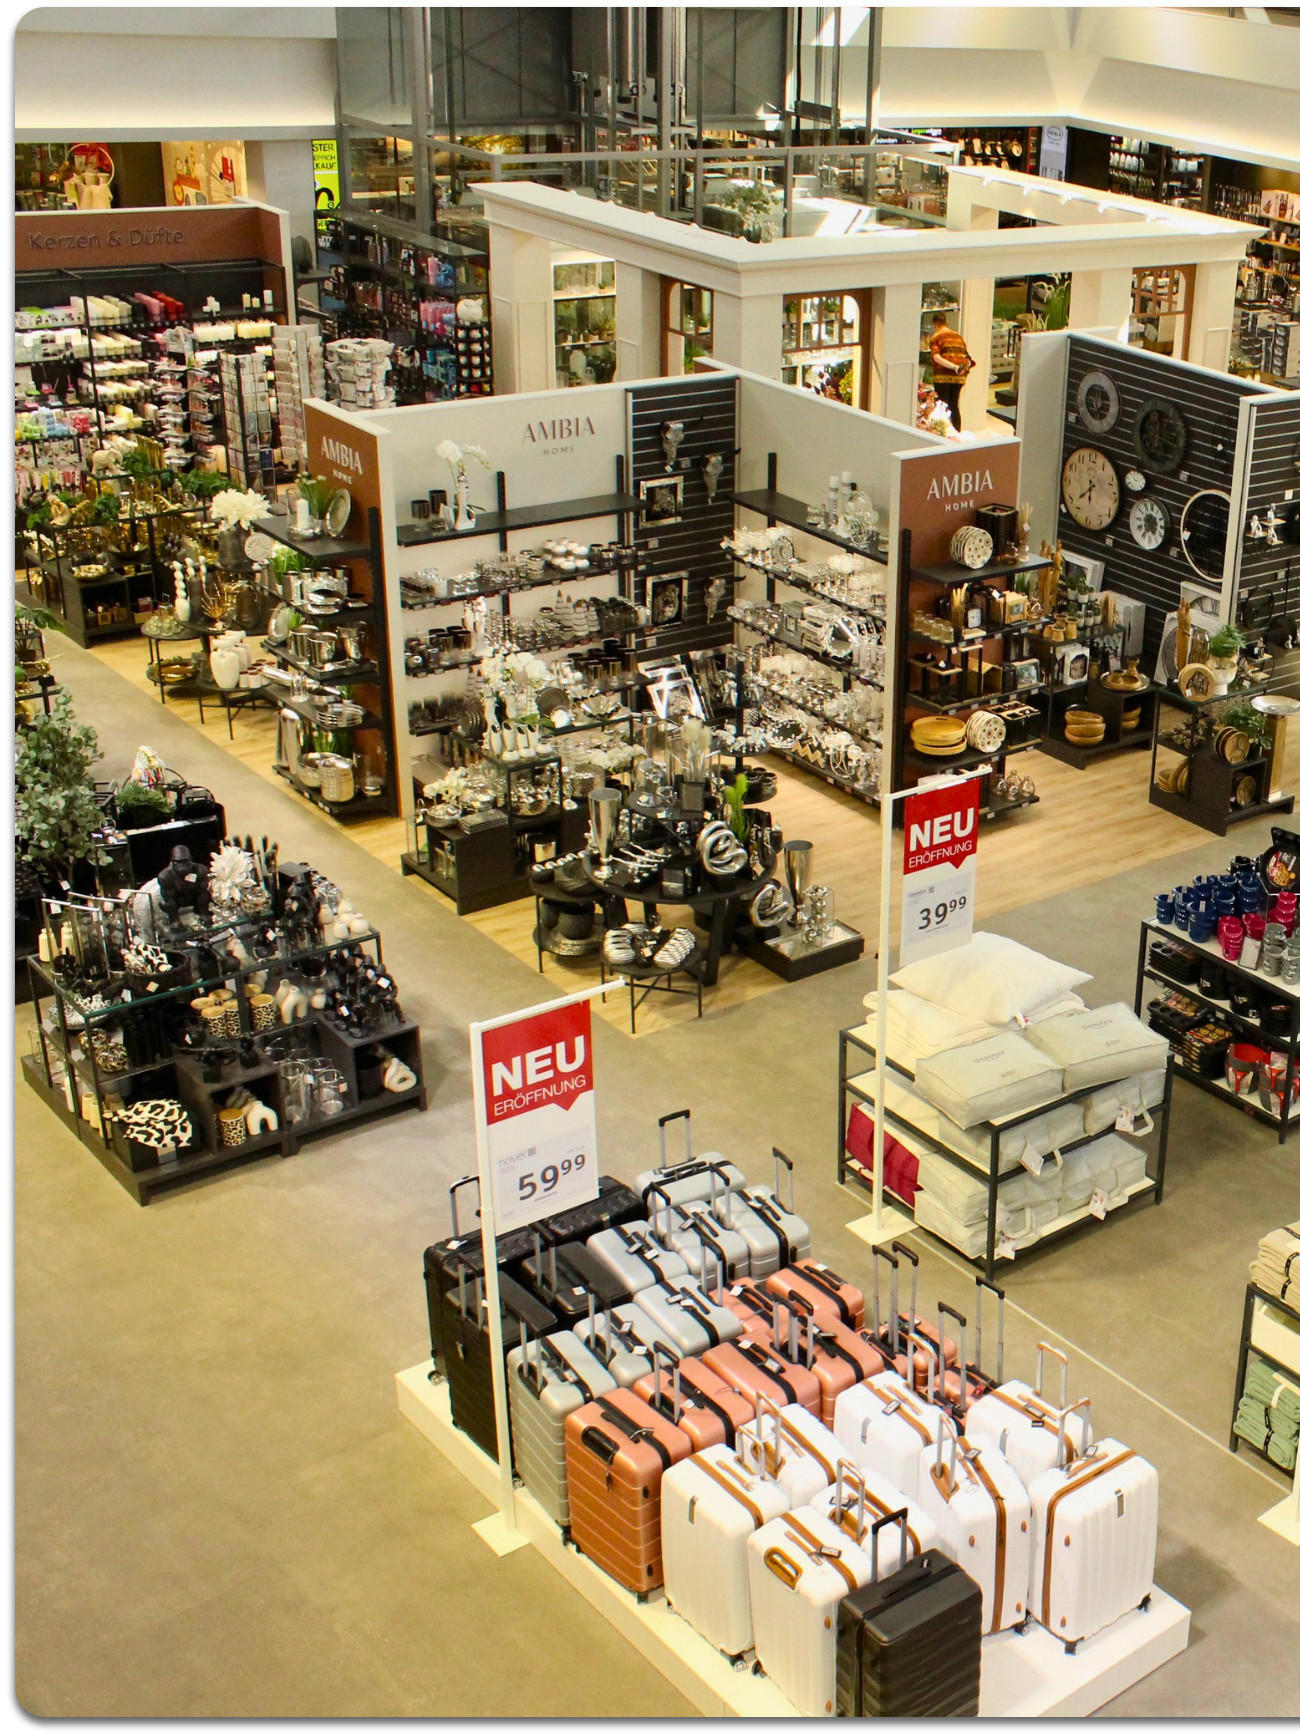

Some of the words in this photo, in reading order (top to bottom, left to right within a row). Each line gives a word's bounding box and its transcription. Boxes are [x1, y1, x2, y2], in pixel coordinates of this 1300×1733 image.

[28, 232, 100, 250] Kerzen
[107, 229, 121, 248] &
[129, 227, 185, 247] Düfte
[522, 416, 596, 443] AMBIA
[320, 436, 363, 475] AMBIA
[543, 446, 575, 455] HOME
[332, 469, 353, 485] HOME
[927, 469, 994, 501] AMBIA
[945, 499, 975, 512] HOME
[910, 807, 975, 852] NEU
[908, 840, 973, 868] ERÖFFNUNG
[491, 1035, 586, 1097] NEU
[494, 1075, 587, 1116] ERÖFFNUNG
